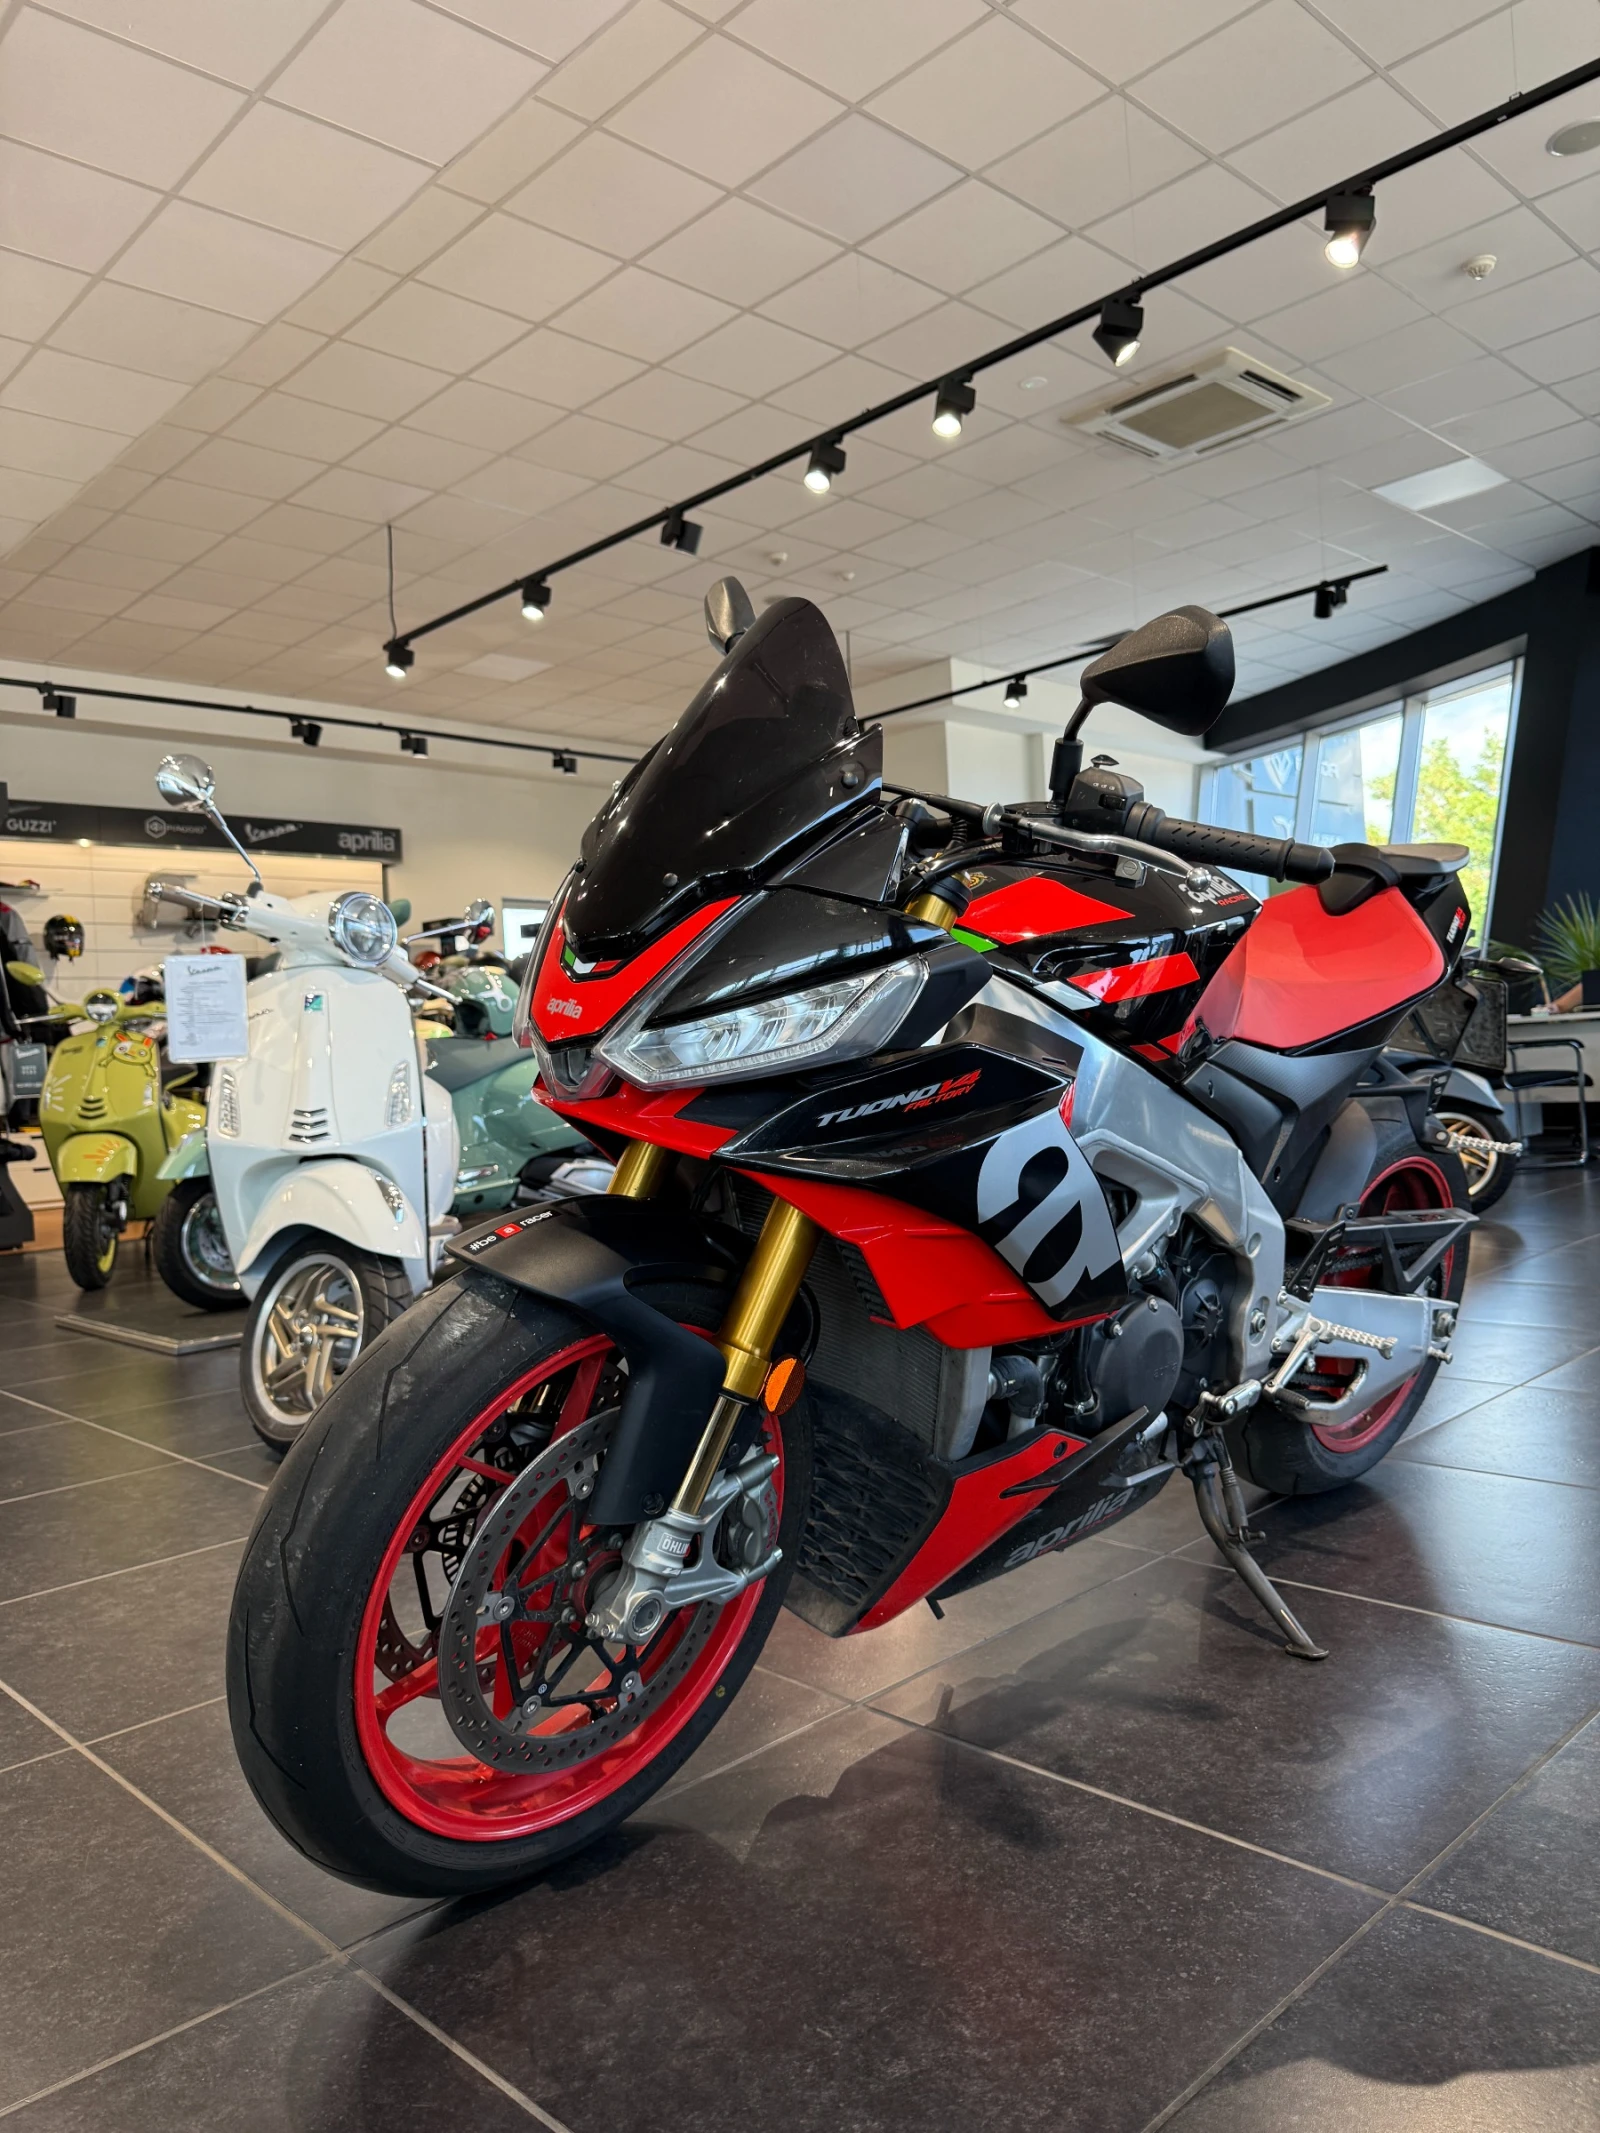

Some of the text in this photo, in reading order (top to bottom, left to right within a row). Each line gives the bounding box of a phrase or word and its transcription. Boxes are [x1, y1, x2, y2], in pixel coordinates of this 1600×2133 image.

[6, 818, 52, 833] GUZZI
[338, 830, 395, 853] aprilia
[1217, 893, 1249, 907] RACING
[547, 998, 583, 1019] aprilia
[817, 1083, 941, 1128] TUONO
[904, 1084, 975, 1113] FACTORY
[469, 1235, 497, 1251] #be
[520, 1210, 553, 1227] racer
[1003, 1487, 1135, 1568] aprilia
[661, 1535, 690, 1554] ÖHLIN
